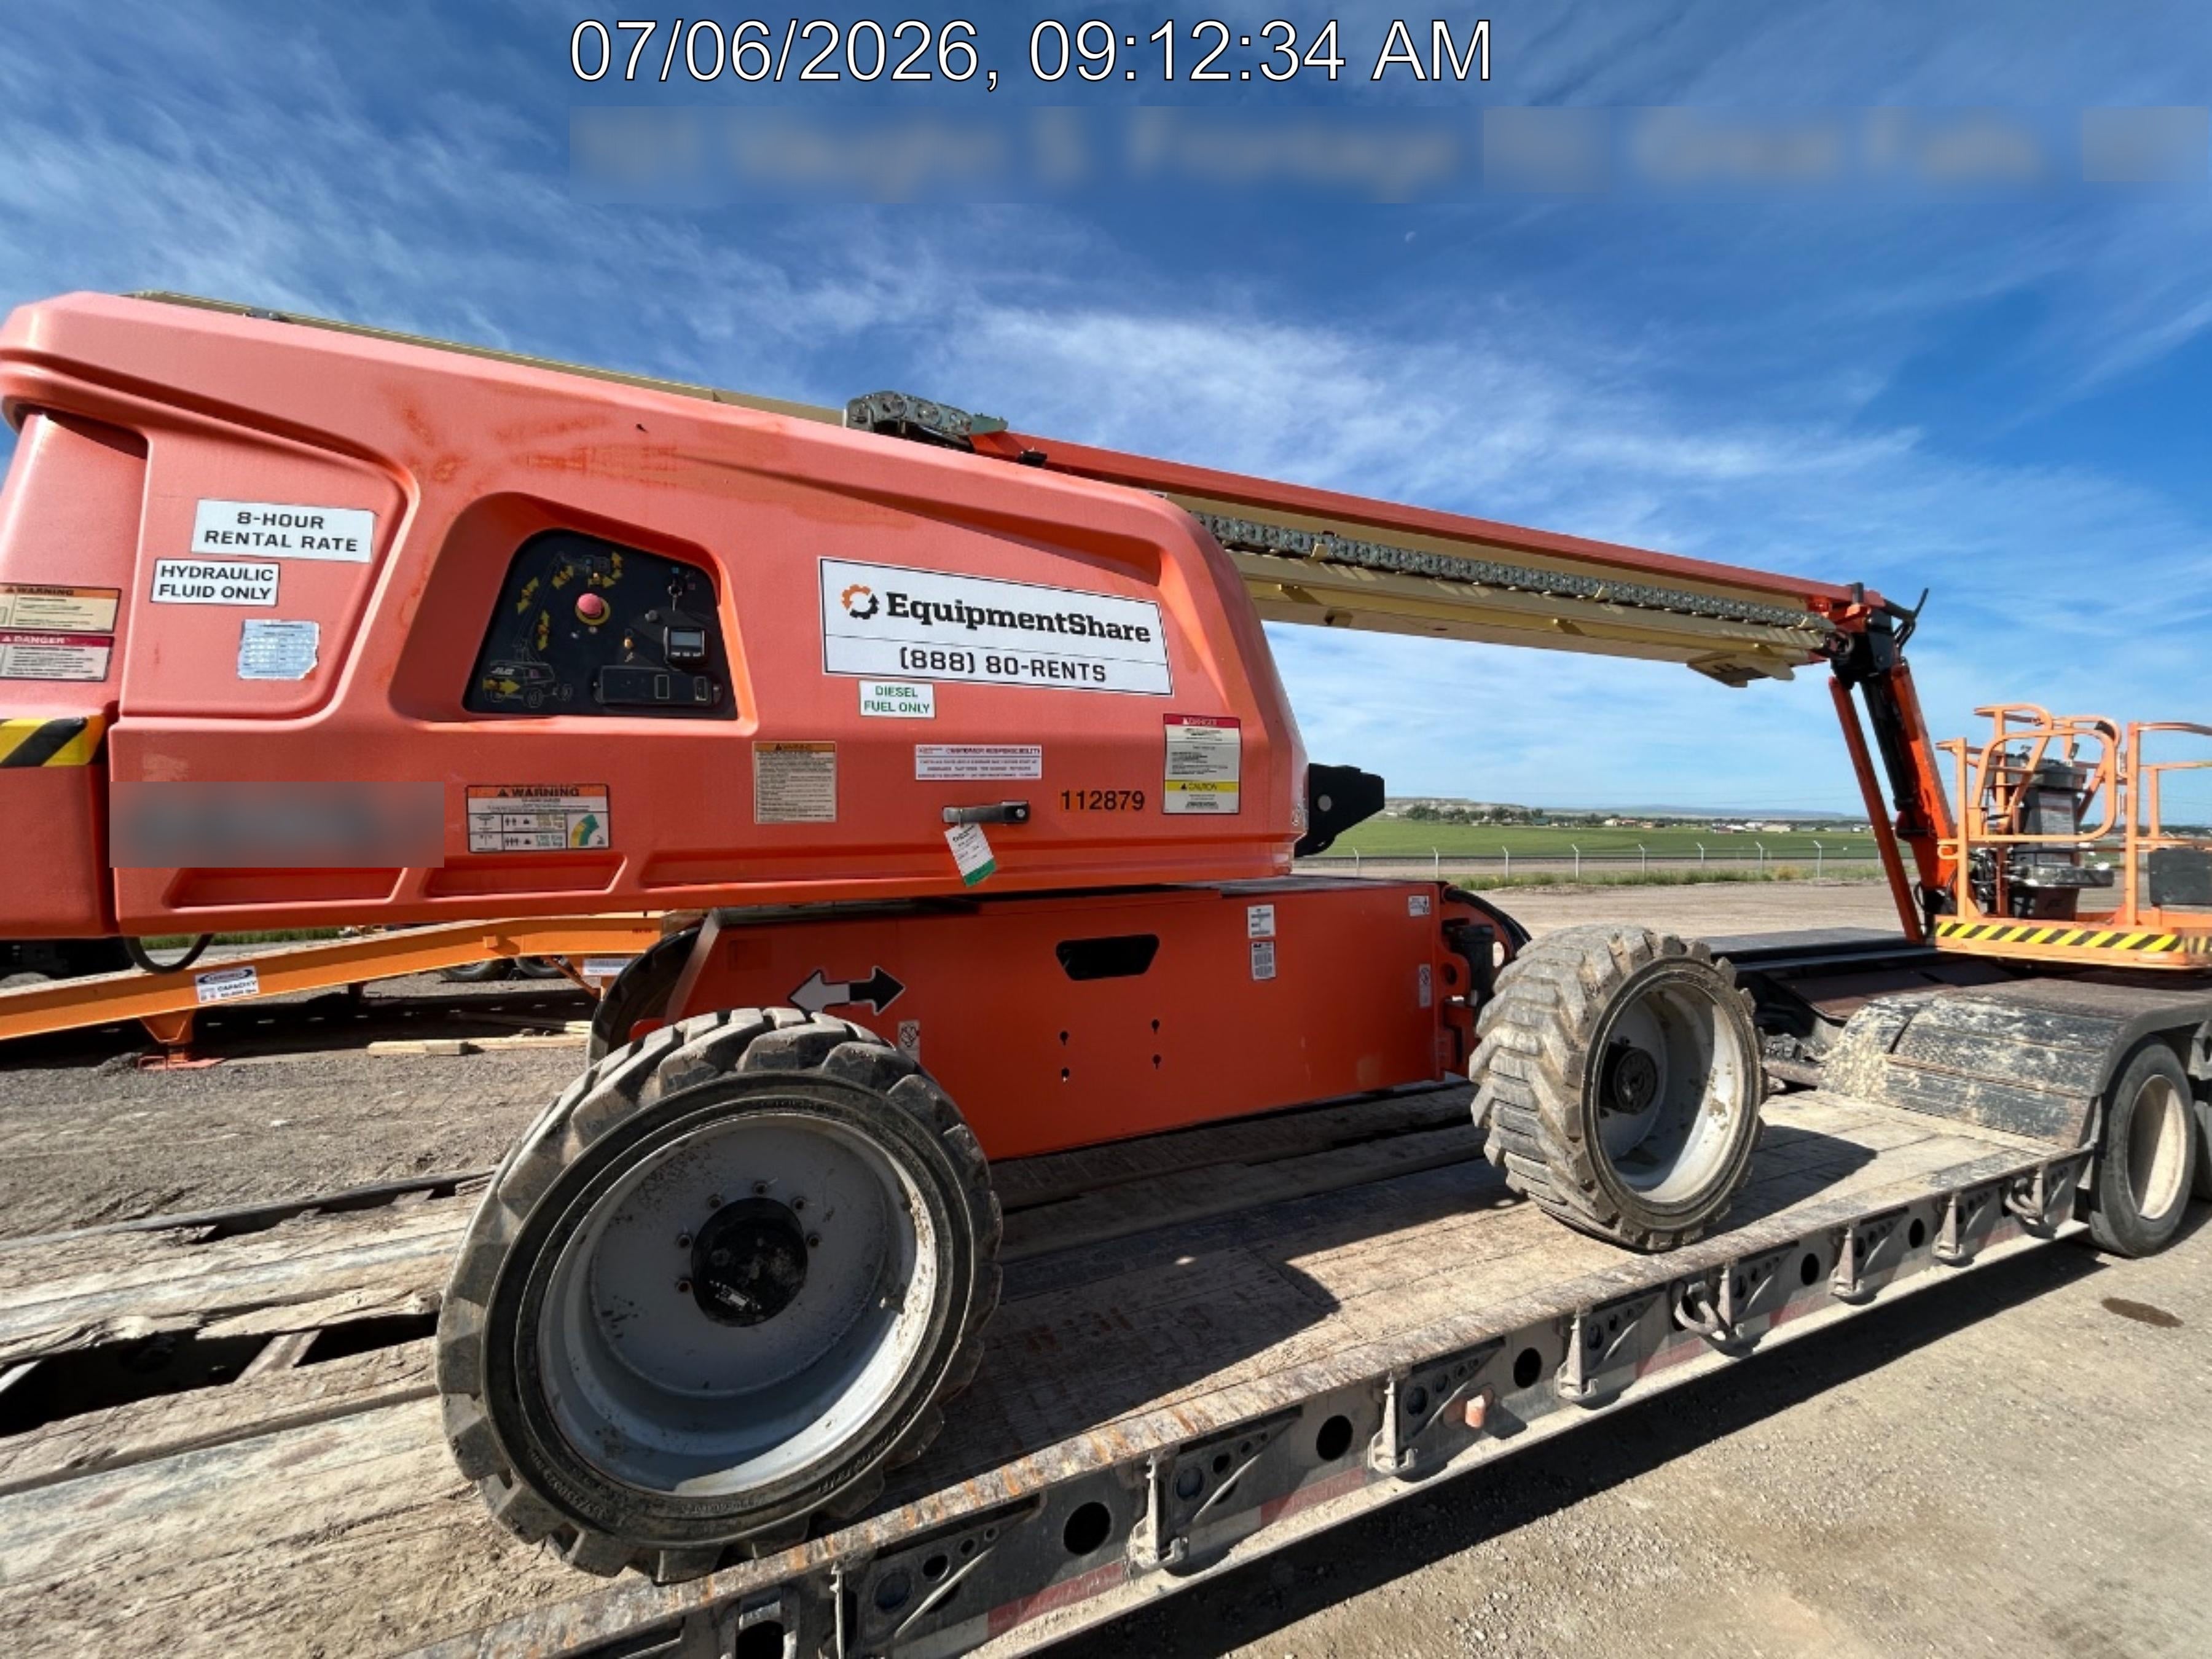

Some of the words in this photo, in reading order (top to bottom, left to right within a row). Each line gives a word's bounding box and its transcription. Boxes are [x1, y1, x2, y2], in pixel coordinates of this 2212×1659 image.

[237, 512, 324, 529] 8-HOUR
[205, 530, 291, 548] RENTAL
[300, 536, 358, 552] RATE
[161, 565, 273, 581] HYDRAULIC
[17, 586, 74, 596] WARNING
[159, 584, 214, 598] FLUID
[221, 586, 272, 600] ONLY
[887, 592, 1151, 643] EquipmentShare
[14, 635, 65, 645] DANGER
[901, 646, 976, 673] (888)
[986, 656, 1107, 682] 80-RENTS
[875, 685, 919, 697] DIESEL
[864, 700, 896, 712] FUEL
[899, 702, 930, 713] ONLY
[511, 788, 580, 797] WARNING
[1061, 789, 1145, 810] 112879
